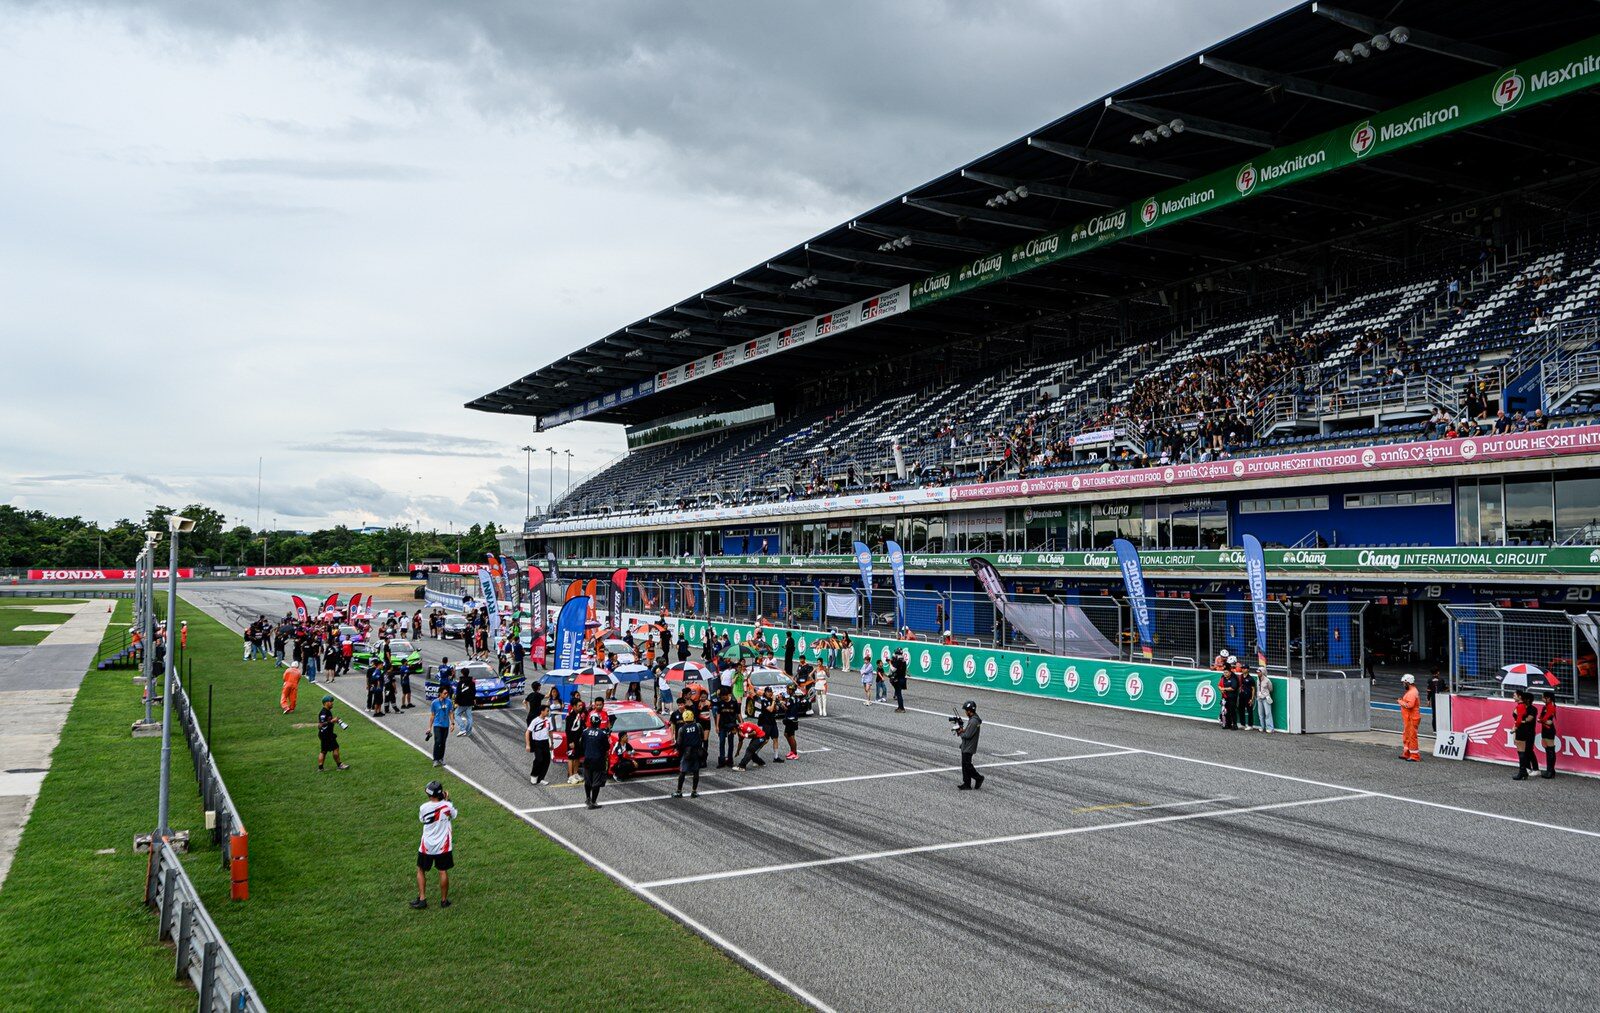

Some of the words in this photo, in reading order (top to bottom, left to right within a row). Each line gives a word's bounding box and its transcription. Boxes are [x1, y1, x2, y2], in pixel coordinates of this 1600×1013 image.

[1380, 105, 1459, 142] Maxnitron
[1260, 150, 1326, 182] Maxnitron
[1161, 189, 1215, 215] Maxnitron
[1088, 211, 1126, 236] Chang
[1026, 235, 1059, 257] Chang
[972, 255, 1002, 276] Chang
[923, 275, 950, 293] Chang
[862, 306, 878, 320] GR
[816, 323, 831, 335] GR
[1483, 441, 1503, 453] PUT
[1506, 439, 1528, 450] OUR
[1248, 463, 1262, 472] PUT
[1264, 461, 1279, 470] OUR
[1313, 458, 1333, 467] INTO
[1334, 455, 1357, 465] FOOD
[1083, 478, 1094, 486] PUT
[1095, 477, 1106, 486] OUR
[1130, 474, 1144, 483] INTO
[1145, 472, 1161, 482] FOOD
[1007, 485, 1018, 493] FOOD
[1033, 510, 1062, 519] Maxnitron
[1102, 504, 1129, 517] Chang
[910, 555, 928, 568] Chang
[1005, 554, 1022, 565] Chang
[1045, 554, 1064, 565] Chang
[1084, 553, 1109, 568] Chang
[1165, 555, 1195, 565] CIRCUIT
[1230, 551, 1246, 564] Cha
[1296, 551, 1326, 565] Chang
[1358, 550, 1400, 569] Chang
[1404, 553, 1492, 565] INTERNATIONAL
[1495, 553, 1547, 565] CIRCUIT
[42, 570, 106, 580] HONDA
[254, 567, 305, 576] HONDA
[318, 565, 364, 574] HONDA
[1210, 582, 1222, 592] 17
[1306, 584, 1321, 594] 18
[1424, 585, 1442, 598] 19
[1566, 587, 1593, 600] 20
[482, 580, 496, 615] RYNNI
[1448, 736, 1455, 746] 3
[1439, 744, 1460, 757] MIN
